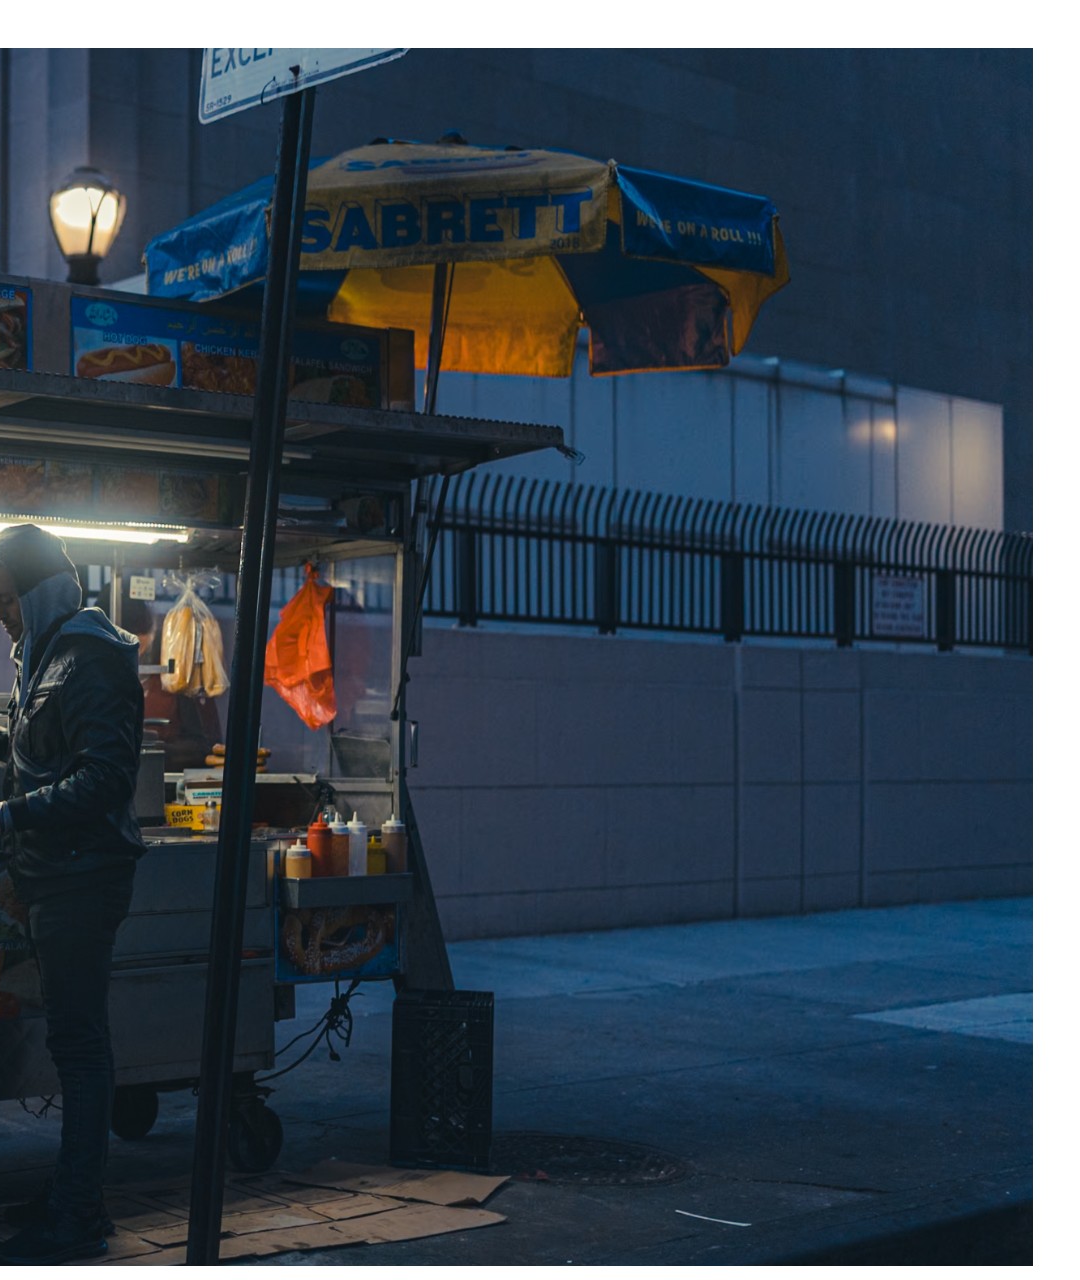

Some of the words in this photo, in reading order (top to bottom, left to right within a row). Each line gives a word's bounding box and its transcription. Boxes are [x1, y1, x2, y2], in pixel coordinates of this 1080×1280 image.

[300, 186, 593, 254] SABRETT
[677, 219, 697, 236] ON
[710, 225, 744, 243] ROLL
[163, 262, 201, 287] WE'RE
[201, 255, 217, 275] ON
[195, 343, 235, 357] CHICKEN
[171, 809, 193, 818] CORN
[172, 816, 194, 824] DOGS
